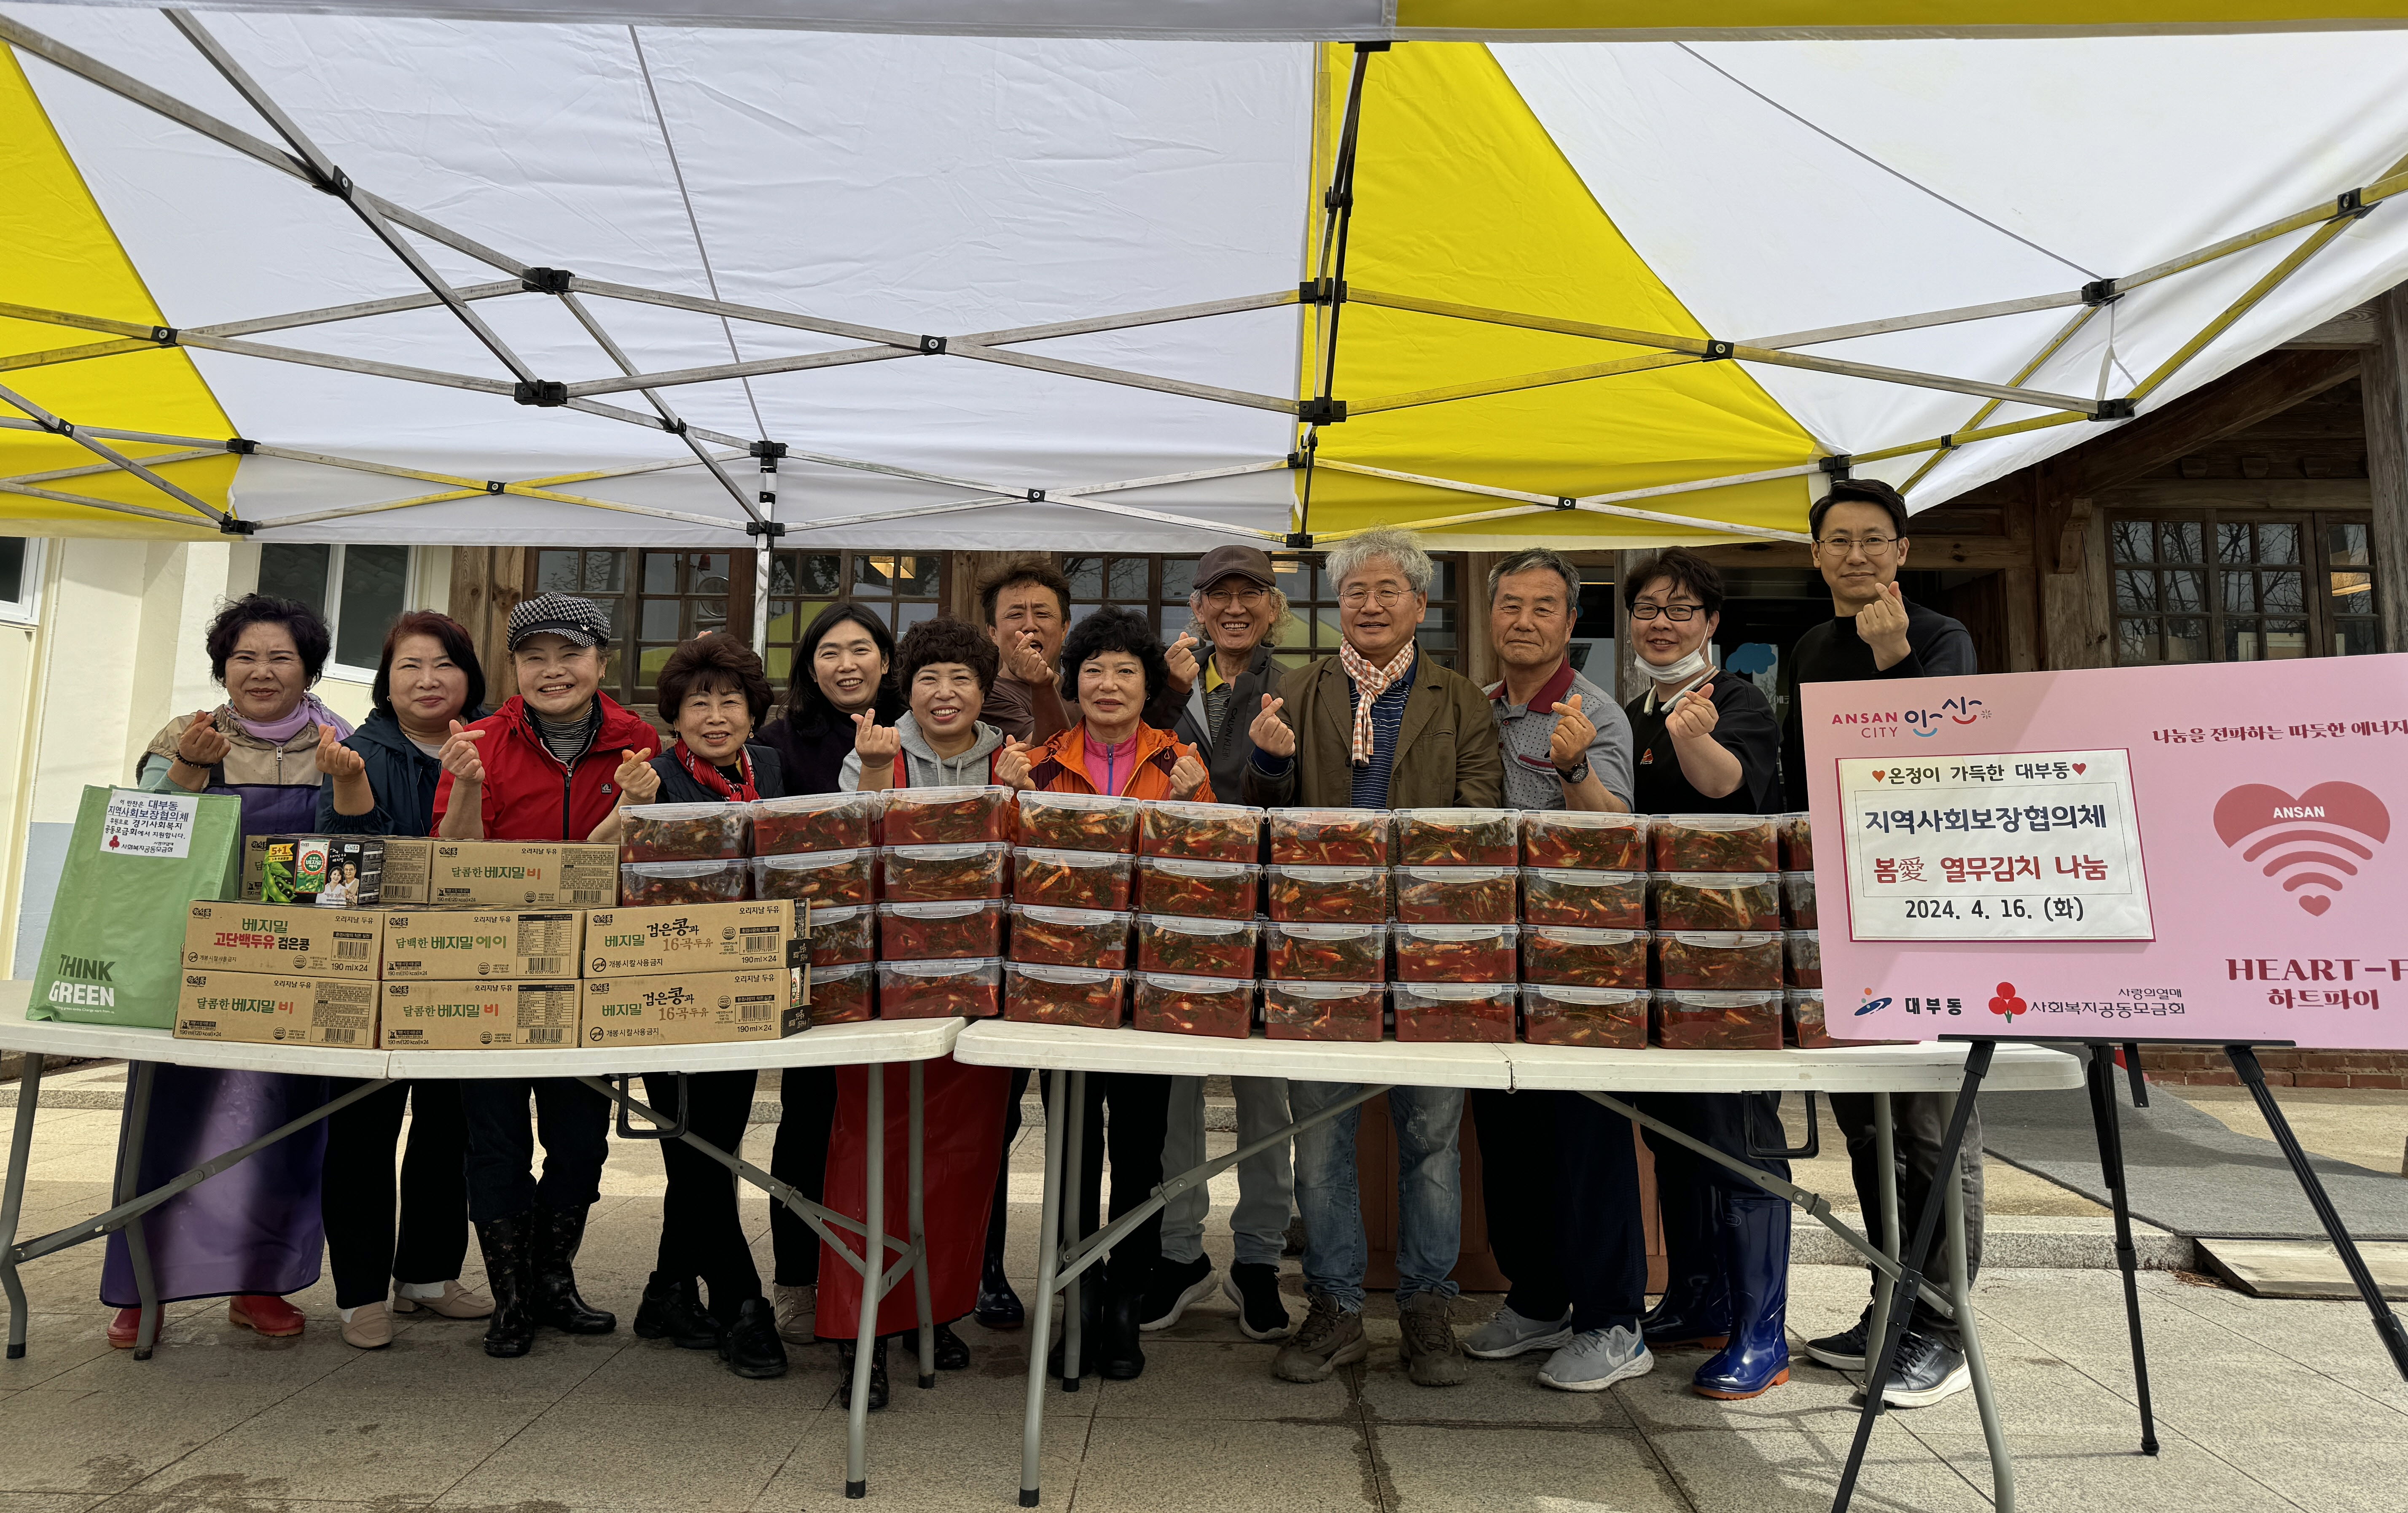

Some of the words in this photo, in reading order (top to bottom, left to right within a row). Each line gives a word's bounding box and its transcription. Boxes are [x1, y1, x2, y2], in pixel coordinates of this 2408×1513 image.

[1224, 707, 1238, 738] CALVIN
[1832, 712, 1897, 724] ANSAN
[1861, 727, 1898, 738] CITY
[2152, 728, 2206, 744] 나눔을
[2210, 725, 2284, 742] 전파하는
[2288, 722, 2347, 739] 따듯한
[2351, 719, 2408, 736] 에너지
[1221, 738, 1232, 761] KLEIN
[1889, 767, 1940, 785] 온정이
[1951, 764, 2005, 782] 가득한
[2016, 762, 2070, 780] 대부동
[148, 800, 178, 810] 대부동
[2273, 806, 2325, 818] ANSAN
[108, 805, 189, 821] 지역사회보장협의체
[1865, 804, 2107, 835] 지역사회보장협의체
[105, 825, 150, 837] 공동모금회에서
[133, 819, 182, 830] 경기사회복지
[271, 845, 290, 855] 5+1
[452, 867, 483, 878] 달콤한
[484, 867, 525, 879] 베지밀
[527, 868, 541, 880] 비
[1873, 856, 1928, 883] 봄愛
[1940, 855, 2041, 883] 열무김치
[2055, 854, 2108, 880] 나눔
[739, 906, 765, 915] 오리지날
[766, 905, 779, 914] 두유
[1905, 899, 1960, 920] 2024.
[1971, 899, 1989, 919] 4.
[2001, 899, 2032, 919] 16.
[2044, 896, 2084, 922] (화)
[242, 918, 288, 934] 베지밀
[334, 915, 360, 923] 오리지날
[646, 918, 699, 937] 검은콩과
[213, 932, 275, 949] 고단백두유
[278, 937, 310, 951] 검은콩
[395, 937, 428, 949] 담백한
[430, 936, 473, 949] 베지밀
[476, 935, 506, 949] 에이
[605, 934, 645, 947] 베지밀
[58, 954, 116, 982] THINK
[331, 963, 344, 971] 190
[274, 980, 298, 988] 오리지날
[734, 975, 760, 983] 오리지날
[48, 980, 114, 1007] GREEN
[642, 987, 695, 1006] 검은콩과
[2118, 988, 2182, 1000] 사랑의열매
[2266, 988, 2379, 1010] 하트파이
[197, 997, 230, 1010] 달콤한
[232, 998, 276, 1014] 베지밀
[278, 1001, 294, 1015] 비
[403, 1005, 436, 1017] 달콤한
[438, 1004, 480, 1018] 베지밀
[484, 1003, 499, 1017] 비
[602, 1003, 642, 1017] 베지밀
[1904, 997, 1962, 1015] 대부동
[2030, 1001, 2185, 1019] 사회복지공동모금회
[646, 1027, 659, 1035] 금지
